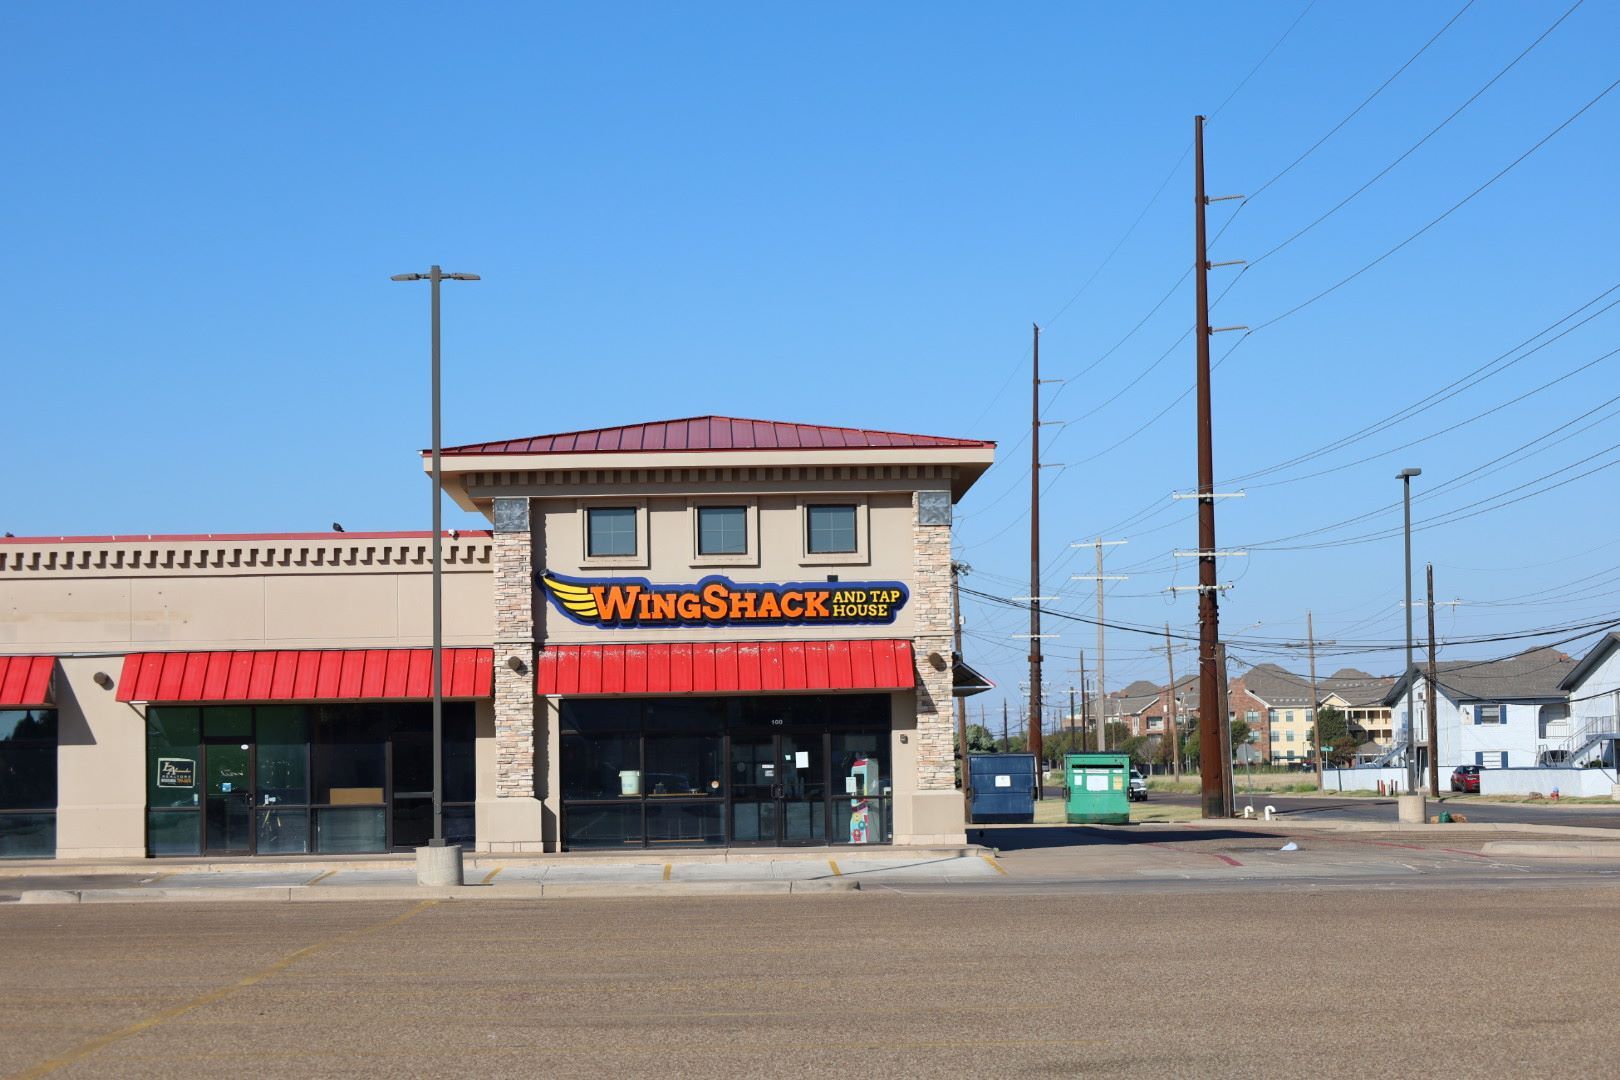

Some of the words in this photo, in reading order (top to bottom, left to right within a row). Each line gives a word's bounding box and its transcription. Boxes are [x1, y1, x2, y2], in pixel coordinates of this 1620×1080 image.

[833, 591, 866, 603] AND
[870, 590, 900, 603] TAP
[833, 604, 888, 617] HOUSE
